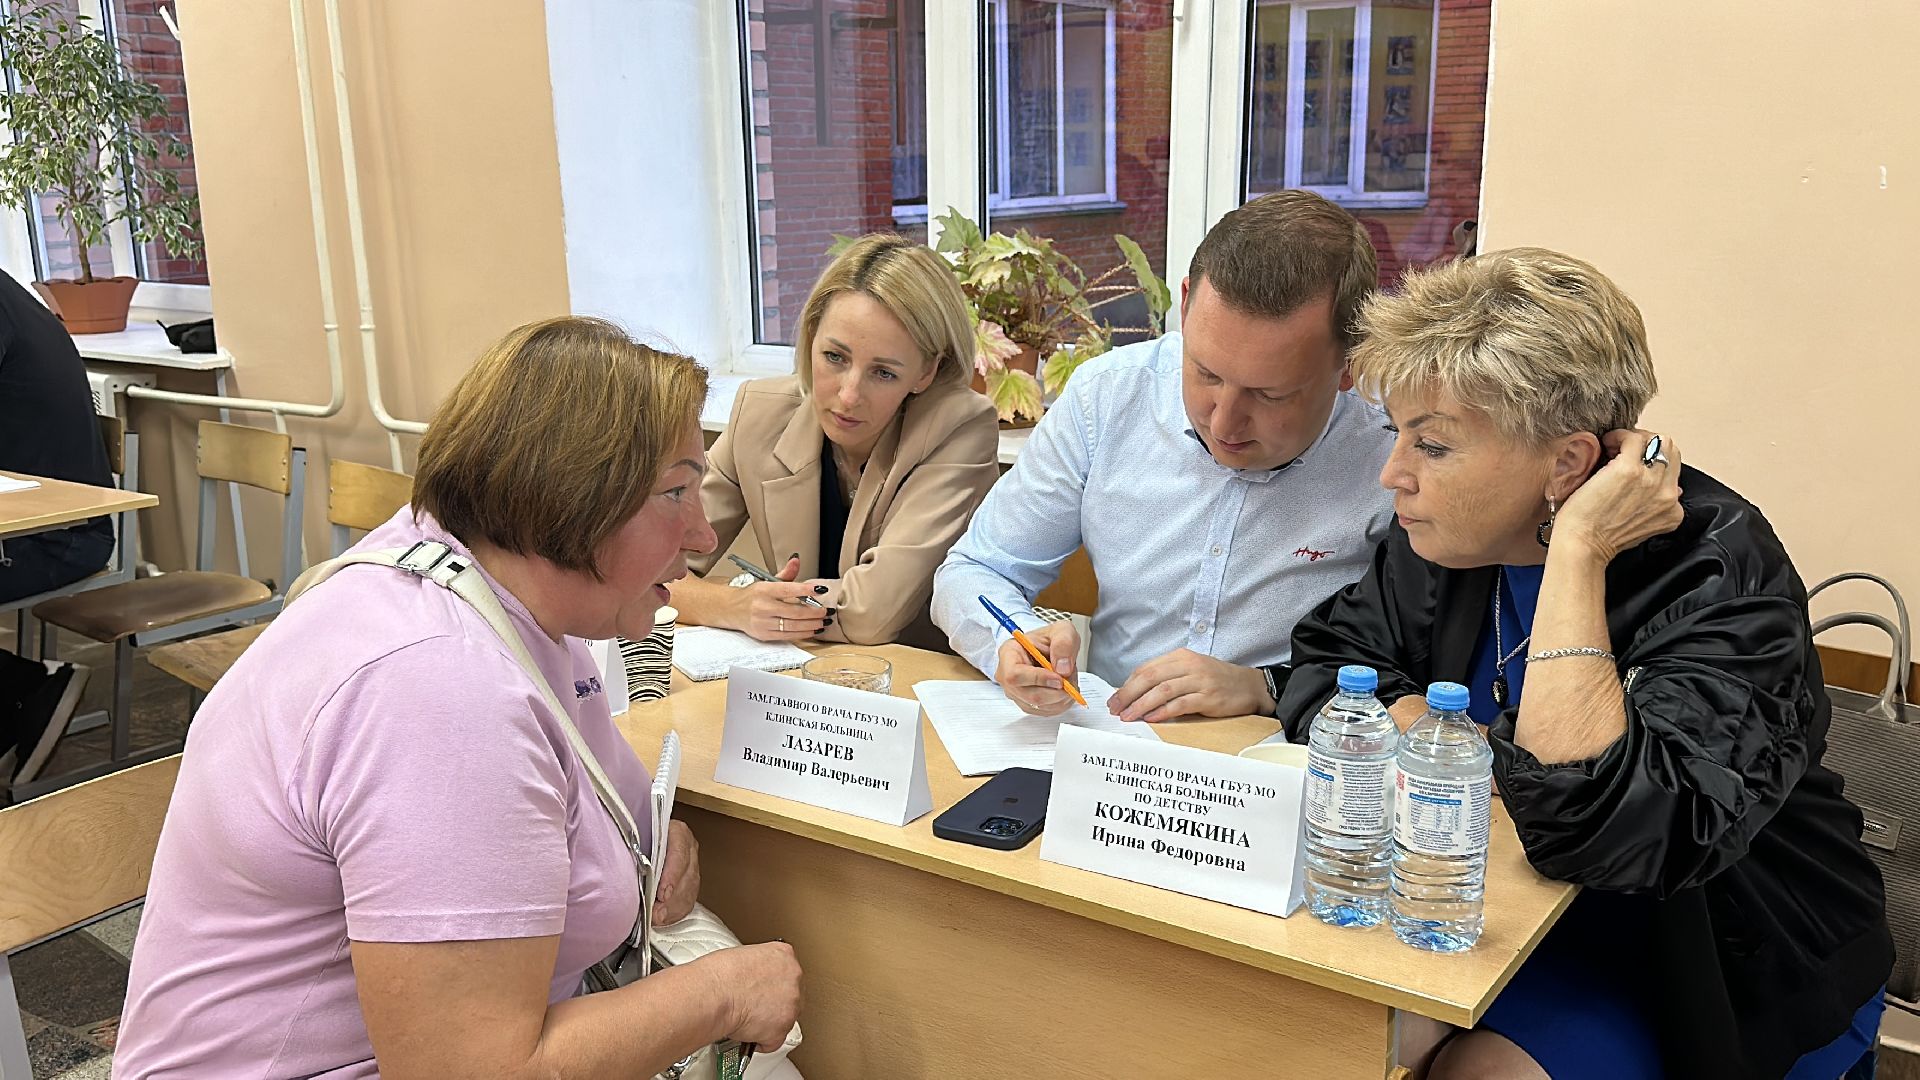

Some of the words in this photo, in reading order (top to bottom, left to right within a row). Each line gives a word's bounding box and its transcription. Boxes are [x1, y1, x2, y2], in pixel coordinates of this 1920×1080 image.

[765, 712, 818, 730] КЛИНСКАЯ
[820, 722, 873, 742] БОЛЬНИЦА
[821, 705, 852, 720] ВРАЧА
[855, 711, 879, 725] ГБУЗ
[882, 716, 898, 729] МО
[782, 734, 854, 761] ЛАЗАРЕВ
[743, 747, 807, 775] Владимир
[811, 762, 890, 791] Валерьевич
[1081, 753, 1174, 779] ЗАМ.ГЛАВНОГО
[1177, 771, 1216, 788] ВРАЧА
[1221, 779, 1251, 794] ГБУЗ
[1254, 785, 1276, 799] МО
[1105, 772, 1172, 794] КЛИНСКАЯ
[1175, 786, 1245, 808] БОЛЬНИЦА
[1134, 792, 1151, 804] ПО
[1154, 796, 1212, 816] ДЕТСТВУ
[1094, 801, 1251, 848] КОЖЕМЯКИНА
[1091, 825, 1145, 851] Ирина
[1151, 838, 1245, 872] Федоровна
